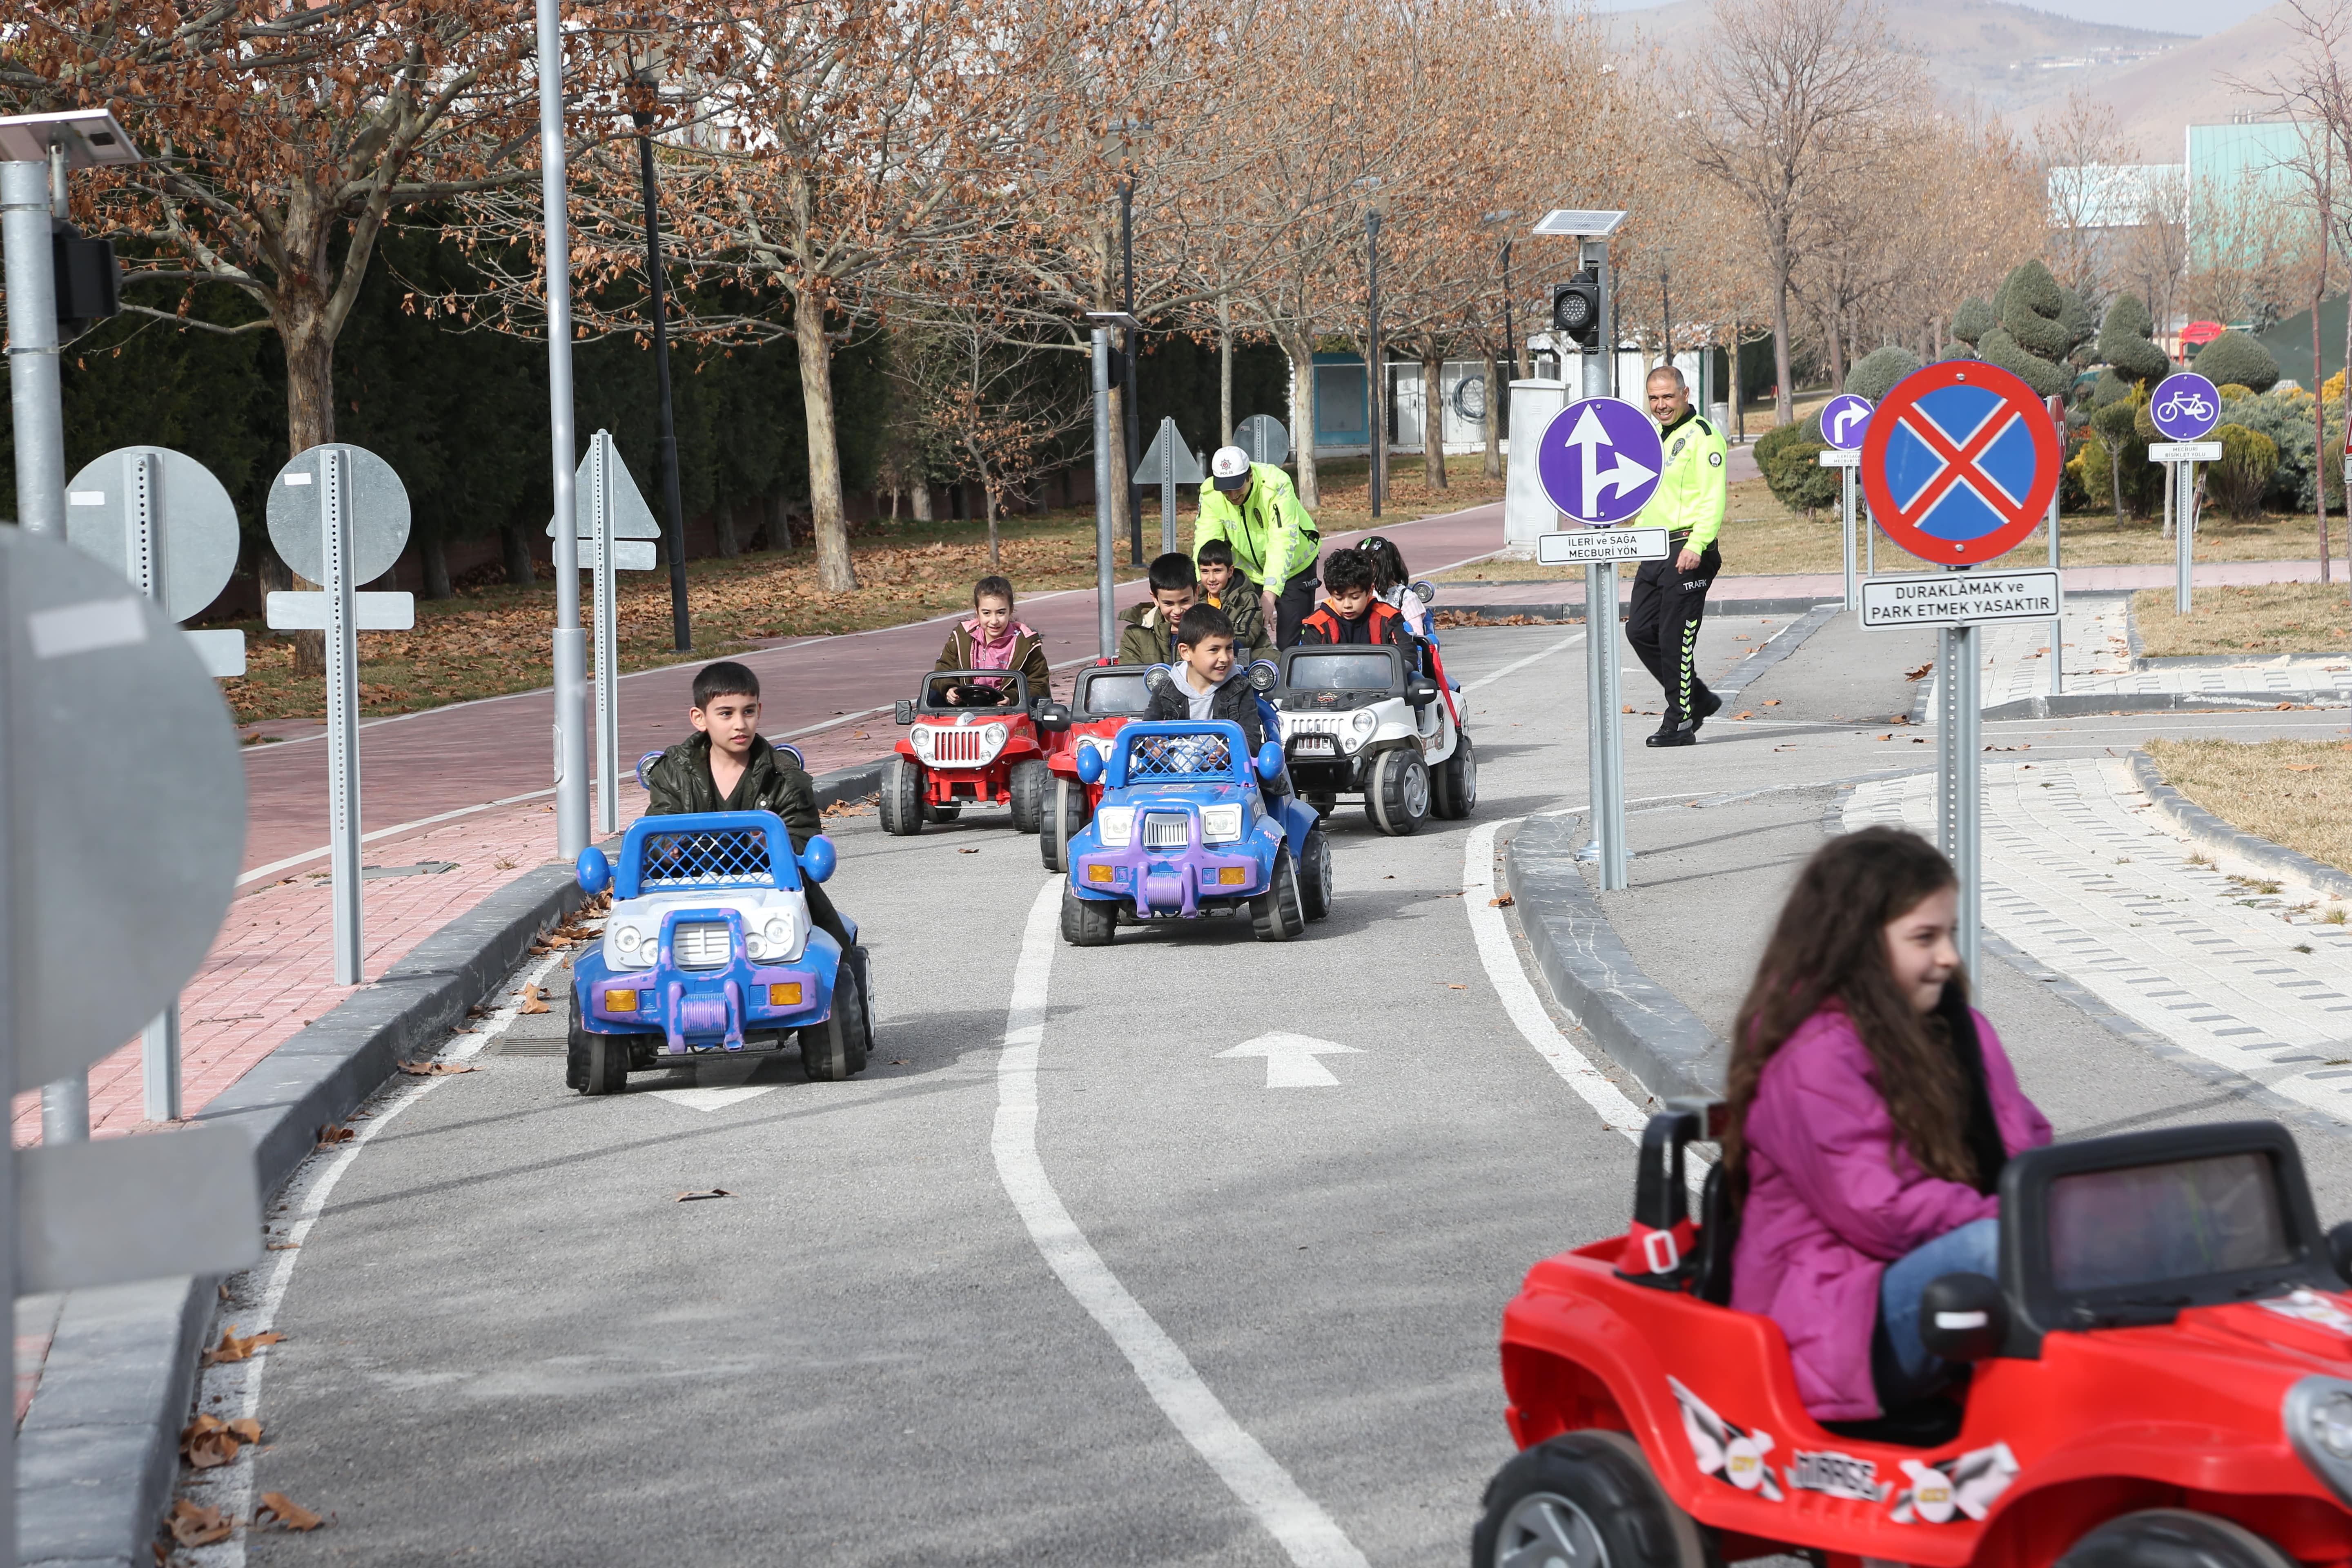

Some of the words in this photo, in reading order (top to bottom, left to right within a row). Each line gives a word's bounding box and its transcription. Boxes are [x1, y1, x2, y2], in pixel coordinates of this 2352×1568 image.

[1568, 535, 1593, 546] İLERİ
[1610, 534, 1637, 544] SAĞA
[1569, 546, 1614, 558] MECBURİ
[1617, 545, 1637, 555] YÖN
[1896, 581, 2004, 599] DURAKLAMAK
[2007, 583, 2025, 592] ve
[1872, 605, 1912, 619] PARK
[1918, 601, 1969, 616] ETMEK
[1973, 597, 2050, 612] YASAKTIR
